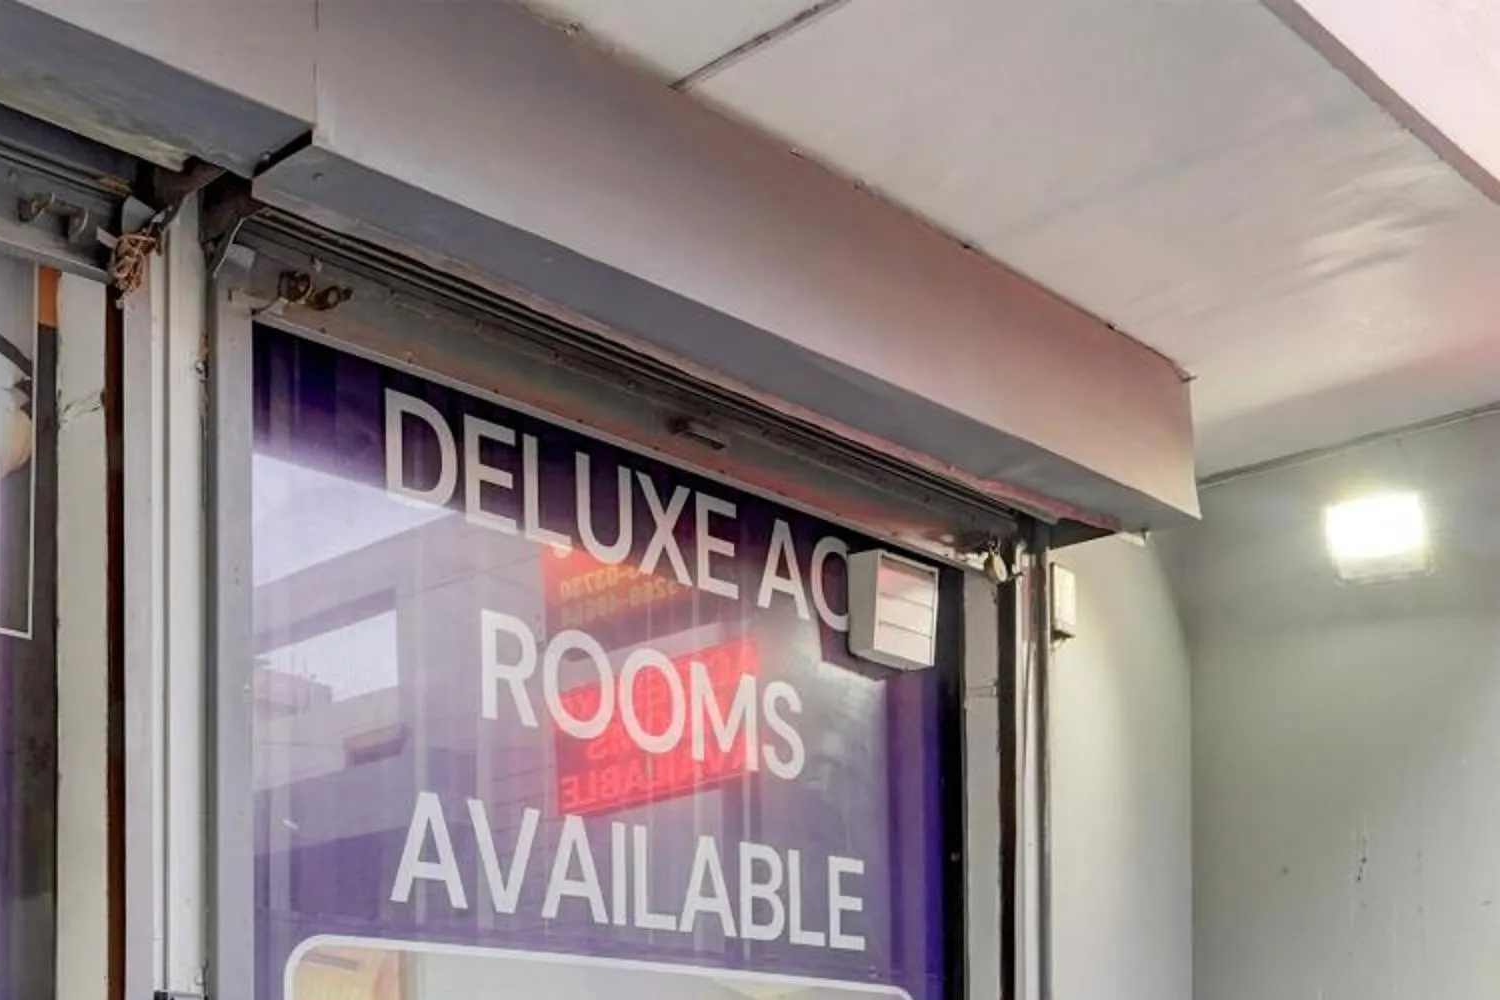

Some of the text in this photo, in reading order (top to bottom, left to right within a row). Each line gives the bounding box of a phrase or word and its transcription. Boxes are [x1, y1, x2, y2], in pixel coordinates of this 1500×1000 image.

[384, 388, 738, 600] DELUXE
[479, 608, 804, 780] ROOMS
[390, 792, 866, 951] AVAILABLE
